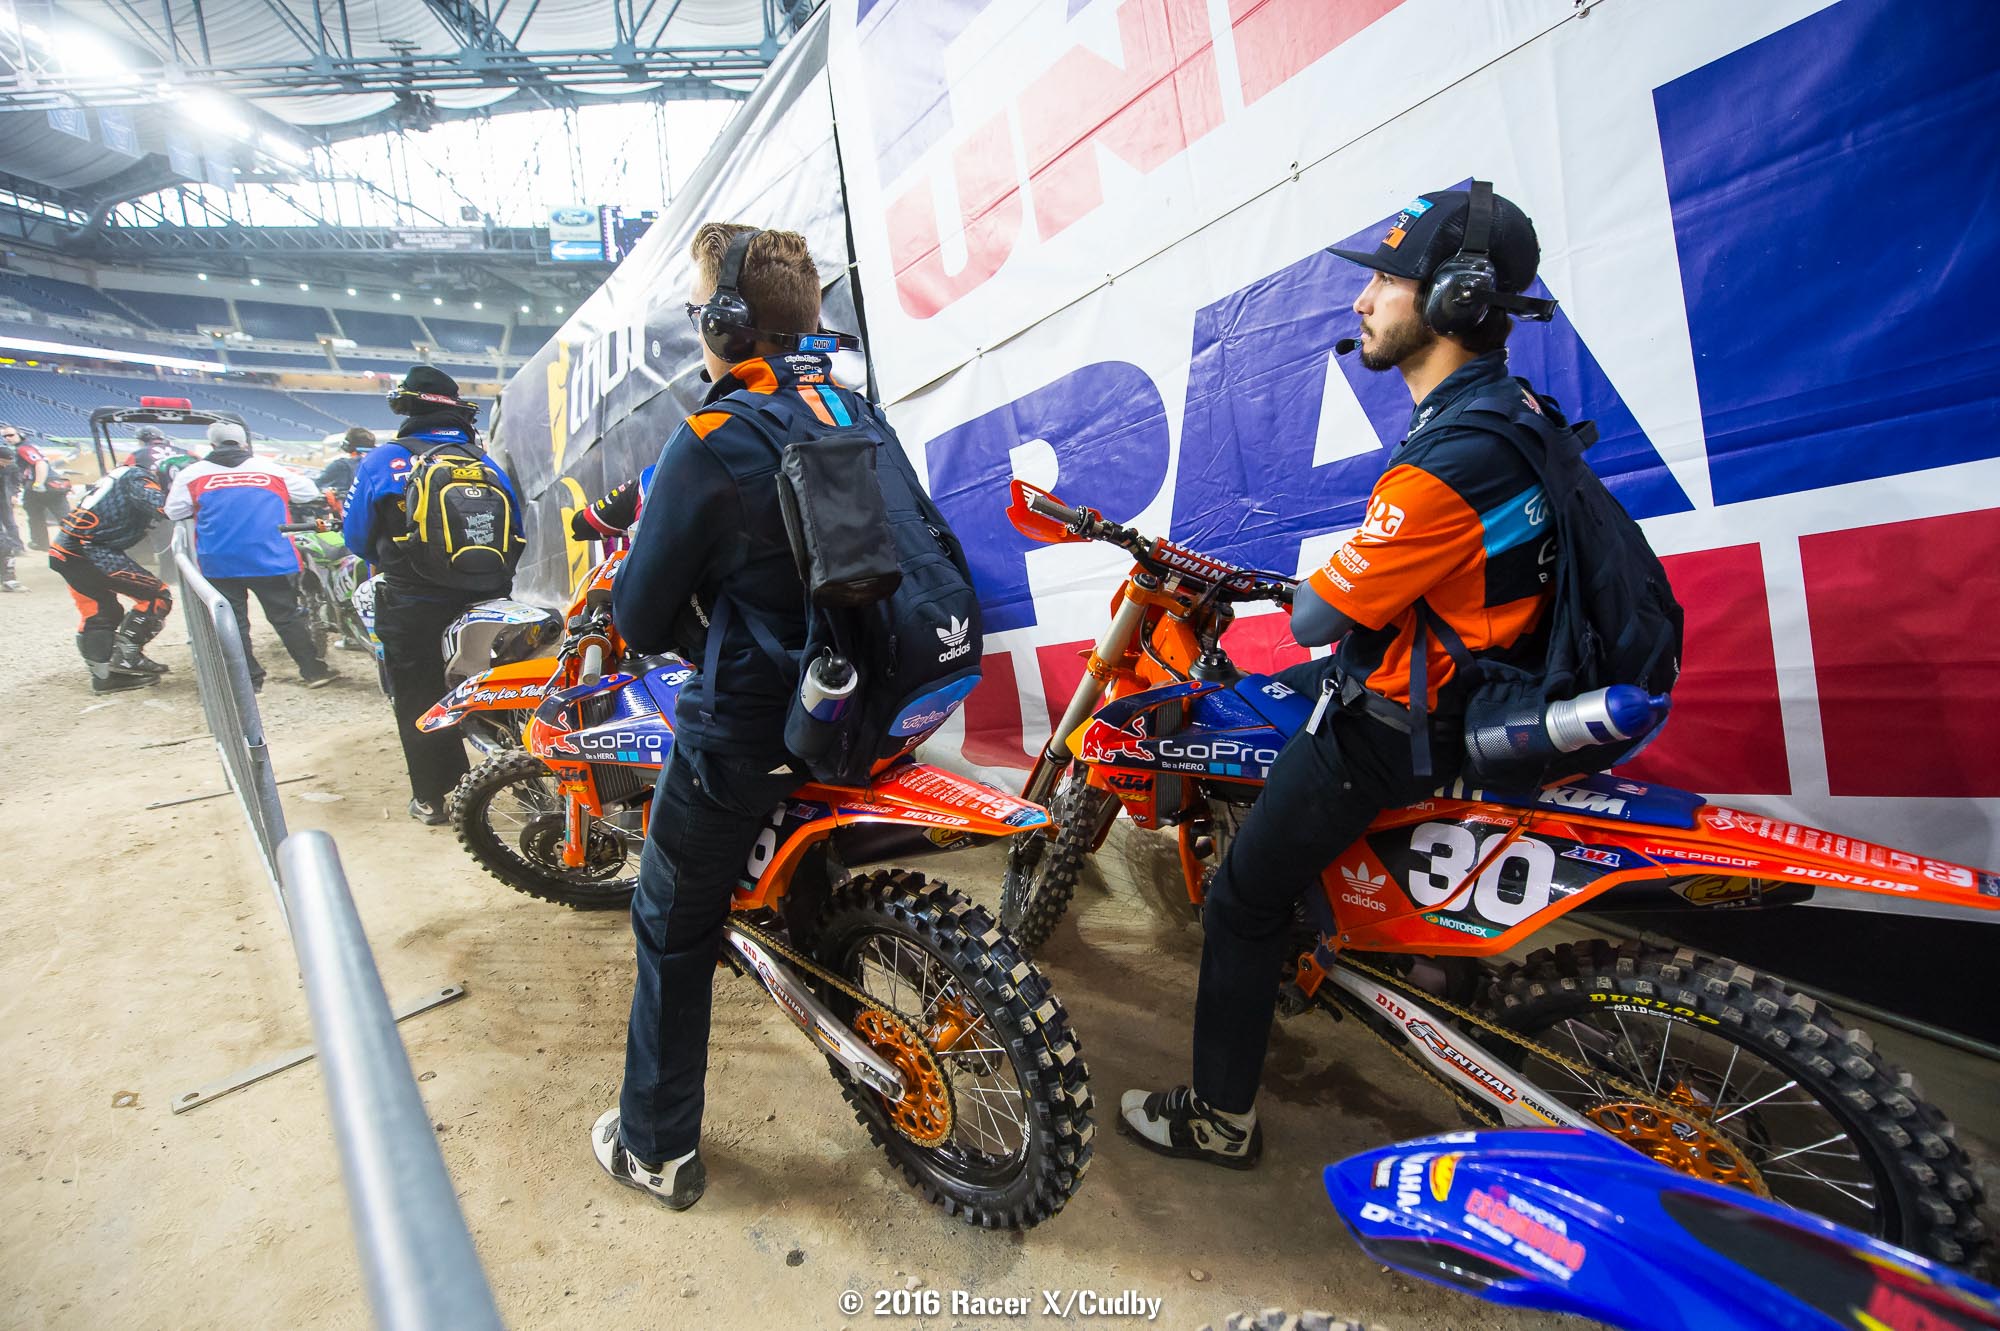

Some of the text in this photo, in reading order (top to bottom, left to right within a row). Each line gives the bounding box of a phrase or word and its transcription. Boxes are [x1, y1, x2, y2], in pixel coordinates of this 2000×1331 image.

[813, 338, 831, 349] ANDY
[792, 364, 822, 372] GoPro
[1159, 548, 1251, 589] RNTHAL
[938, 645, 971, 663] adidas
[473, 690, 498, 705] Troy
[497, 687, 519, 700] Lee
[1261, 681, 1296, 700] 30
[579, 732, 662, 749] GoPro
[1158, 739, 1279, 764] GoPro
[1161, 761, 1172, 769] Be
[1178, 762, 1206, 771] HERO.
[1108, 772, 1153, 791] KTM
[839, 802, 896, 814] LIFEPROOF
[1538, 788, 1627, 815] KTM
[901, 811, 970, 827] DUNLOP
[1493, 817, 1515, 827] Air
[1565, 845, 1620, 867] AMA
[1644, 846, 1761, 867] LIFEPROOF
[1408, 822, 1556, 927] 30
[1781, 865, 1920, 893] DUNLOP
[1341, 891, 1388, 913] adidas
[1438, 916, 1488, 938] MOTOREX
[1588, 993, 1721, 1026] DUNLOP
